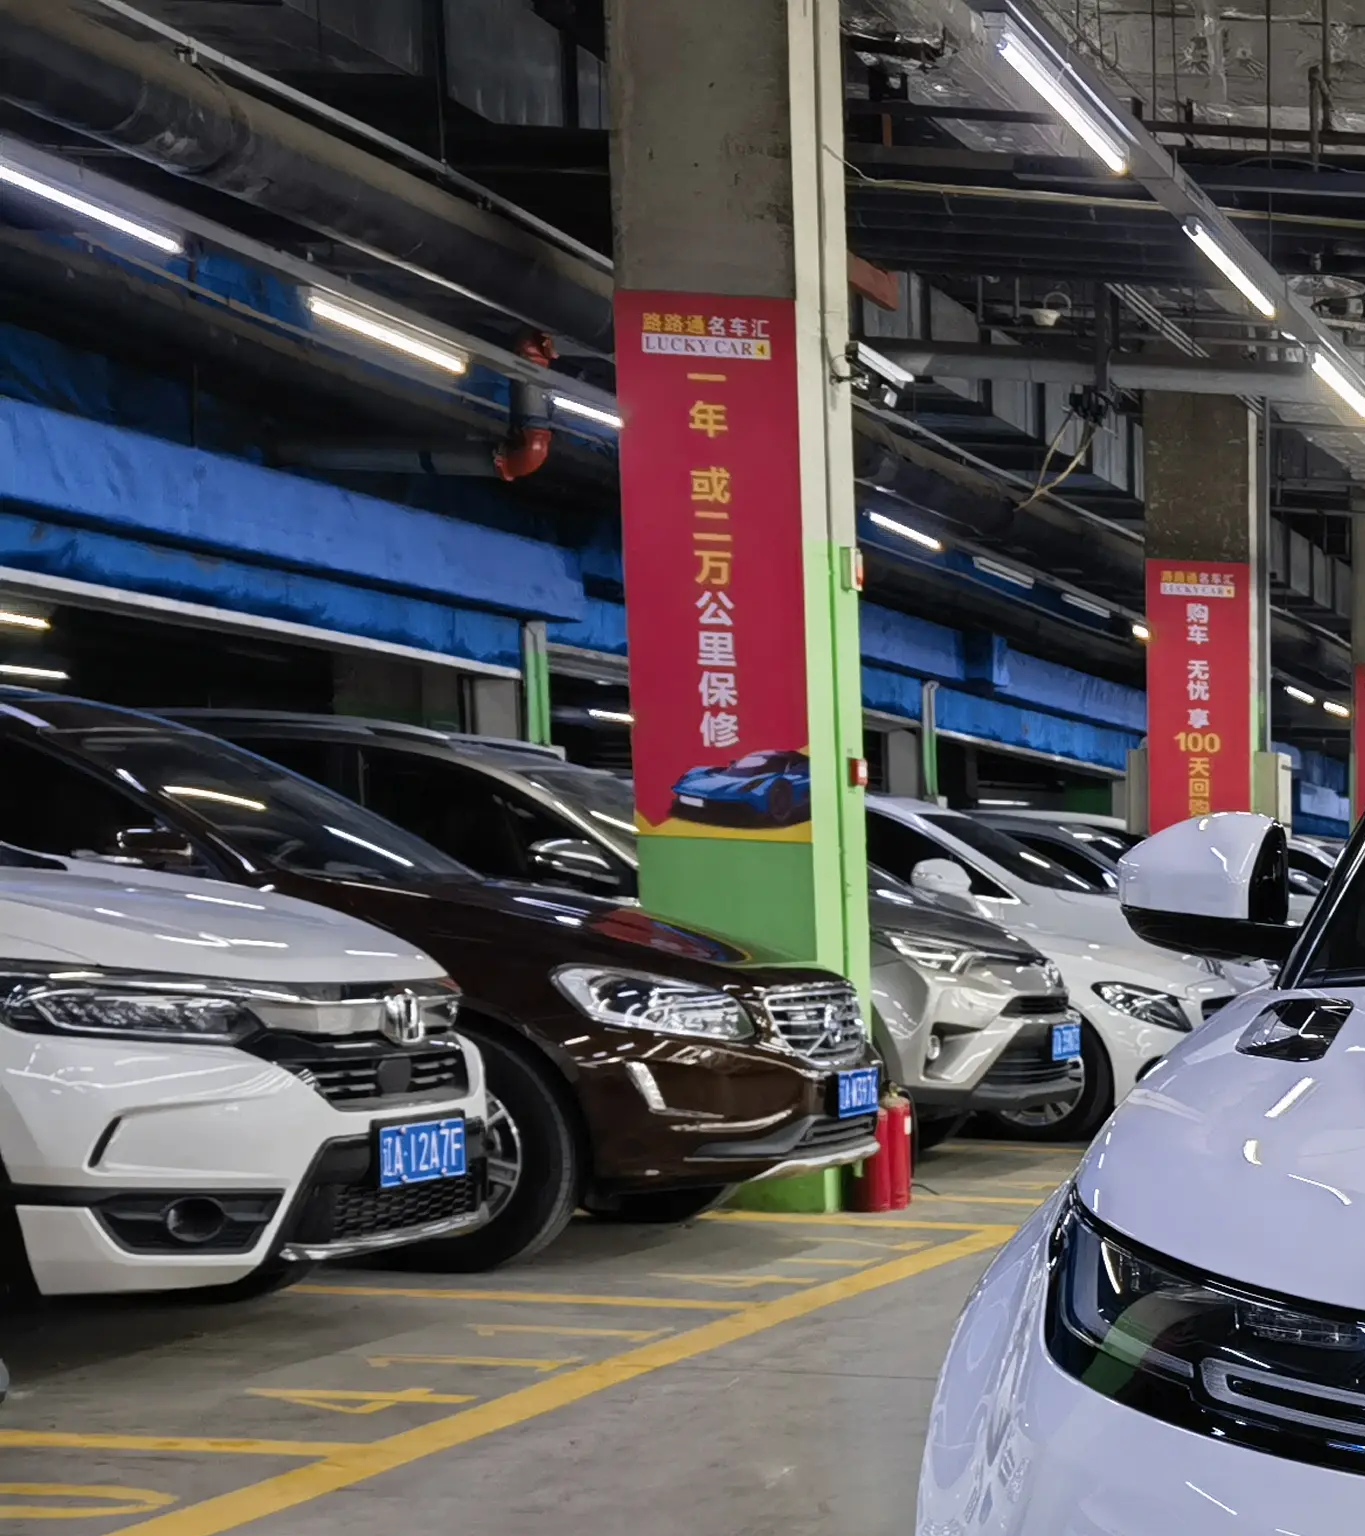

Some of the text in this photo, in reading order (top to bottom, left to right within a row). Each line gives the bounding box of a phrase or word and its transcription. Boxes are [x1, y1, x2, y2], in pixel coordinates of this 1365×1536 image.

[641, 312, 770, 338] 路路通名车汇
[645, 335, 752, 356] LUCKY CAR
